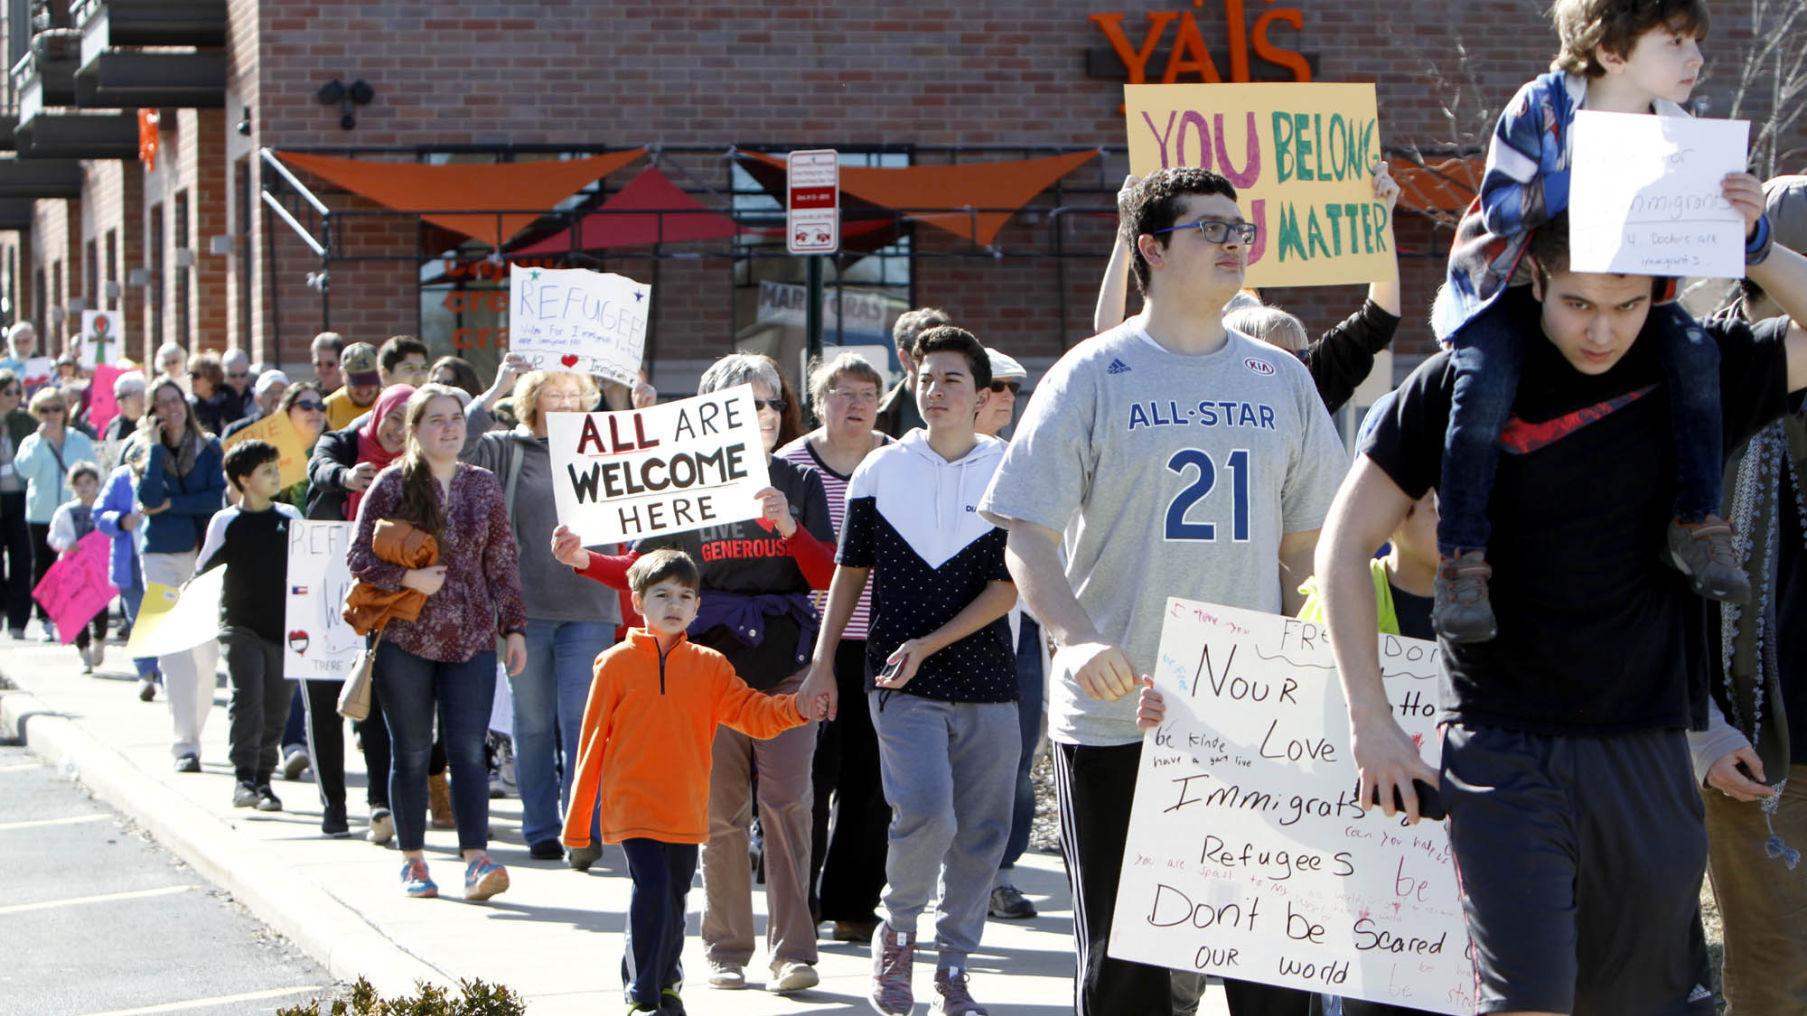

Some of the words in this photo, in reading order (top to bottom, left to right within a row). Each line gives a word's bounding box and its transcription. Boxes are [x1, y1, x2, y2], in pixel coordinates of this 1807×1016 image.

[1141, 110, 1261, 189] YOU
[1272, 111, 1380, 184] BELONG
[1278, 200, 1388, 263] MATTER
[1246, 358, 1273, 375] KIA
[576, 412, 660, 454] ALL
[674, 397, 743, 442] ARE
[567, 442, 748, 504] WELCOME
[1164, 448, 1251, 543] 21
[618, 495, 717, 534] HERE
[700, 522, 744, 541] LIVE
[1259, 718, 1338, 763] Love
[1394, 855, 1429, 902] be
[1286, 900, 1326, 944] be
[1194, 945, 1240, 969] OUR
[1279, 956, 1350, 985] world
